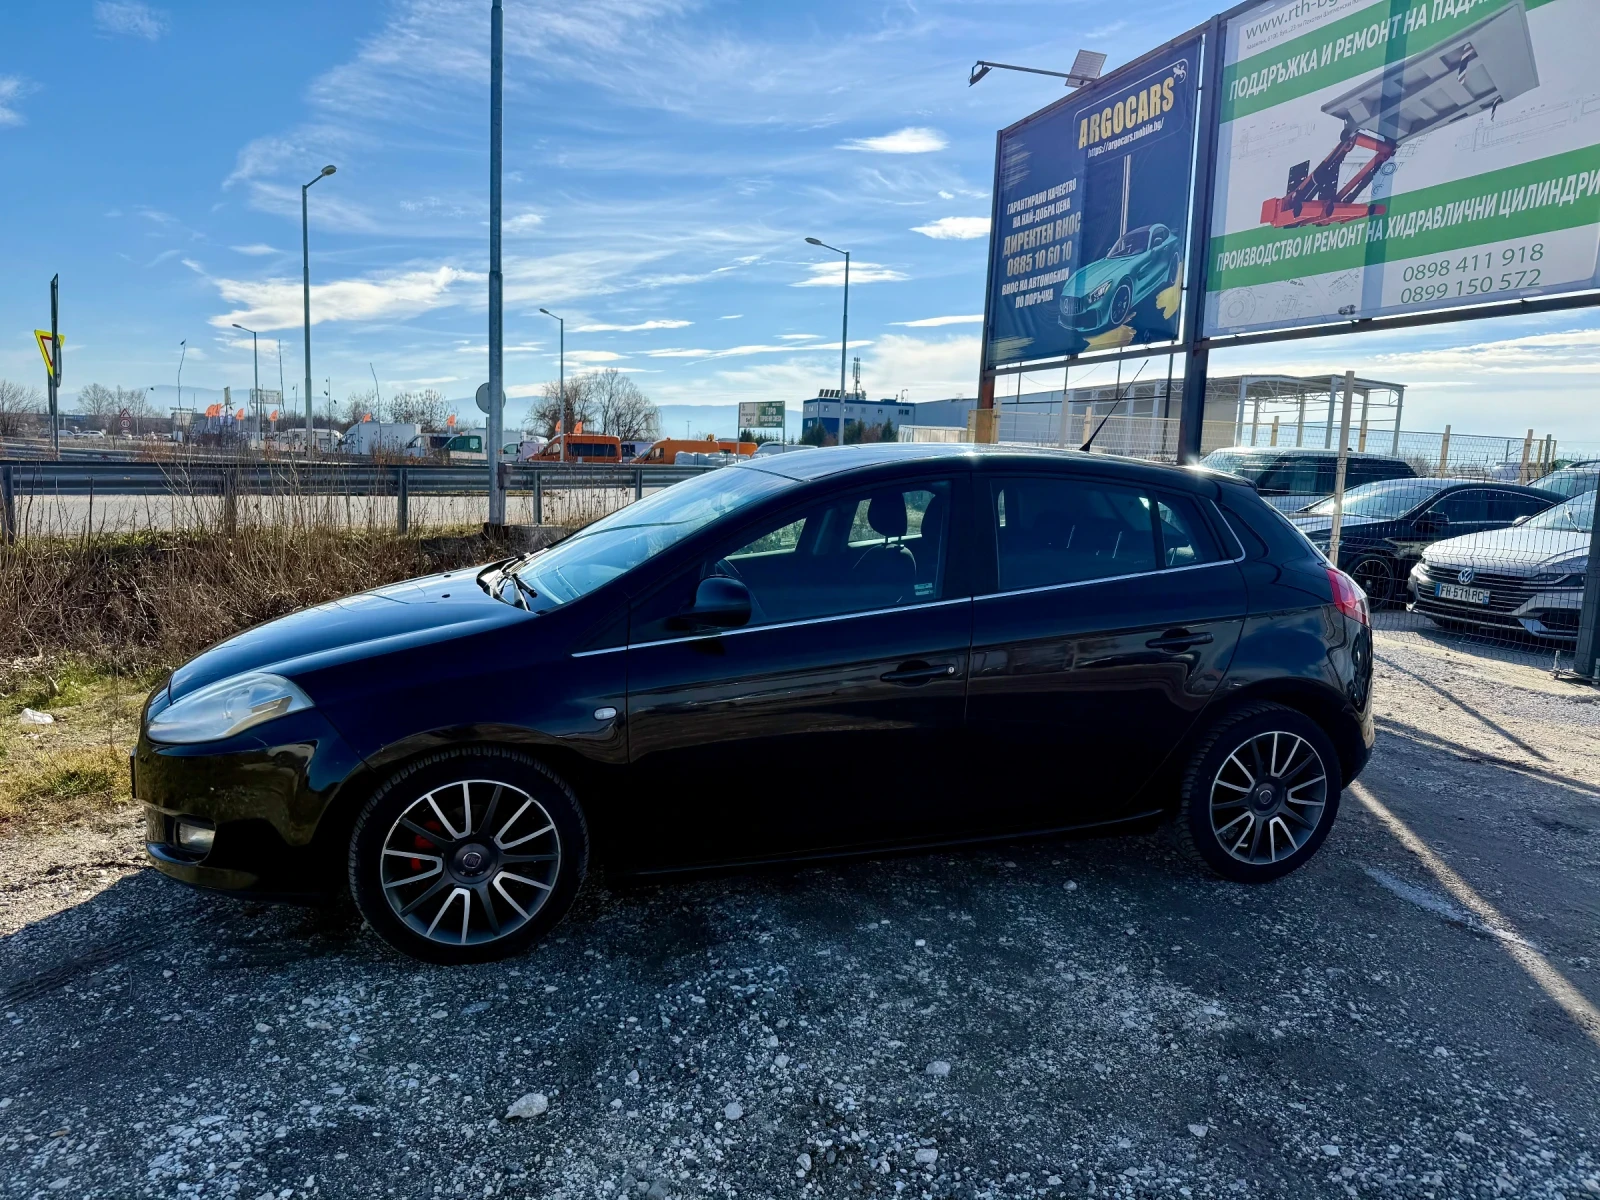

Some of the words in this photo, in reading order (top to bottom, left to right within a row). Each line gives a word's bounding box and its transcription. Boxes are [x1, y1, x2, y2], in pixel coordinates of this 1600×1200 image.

[1229, 48, 1318, 101] ПОДДРЪЖКА
[1320, 42, 1333, 68] И
[1333, 13, 1402, 62] РЕМОНТ
[1402, 3, 1427, 35] НА
[1079, 77, 1174, 149] ARGOCARS
[1088, 117, 1164, 158] https://argocars.mobile.bg/
[1007, 190, 1047, 215] ГАРАНТИРАНО
[1047, 178, 1077, 200] КАЧЕСТВО
[1013, 216, 1021, 229] НА
[1021, 204, 1055, 226] НАЙ-ДОБРА
[1055, 198, 1071, 216] ЦЕНА
[1002, 222, 1054, 258] ДИРЕКТЕН
[1055, 211, 1081, 240] ВНОС
[1216, 236, 1301, 272] ПРОИЗВОДСТВО
[1302, 235, 1313, 256] И
[1313, 222, 1365, 254] РЕМОНТ
[1365, 219, 1383, 244] НА
[1385, 192, 1498, 240] ХИДРАВЛИЧНИ
[1498, 168, 1600, 218] ЦИЛИНДРИ
[1007, 253, 1033, 277] 0885
[1034, 249, 1045, 269] 10
[1047, 244, 1060, 266] 60
[1061, 240, 1072, 262] 10
[1403, 259, 1450, 283] 0898
[1455, 251, 1493, 273] 411
[1501, 243, 1544, 267] 918
[1002, 281, 1019, 296] ВНОС
[1019, 279, 1028, 292] НА
[1028, 267, 1070, 289] АВТОМОБИЛИ
[1015, 295, 1024, 309] ПО
[1024, 288, 1054, 307] ПОРЪЧКА
[1400, 282, 1448, 304] 0899
[1456, 276, 1493, 297] 150
[1498, 268, 1541, 290] 572
